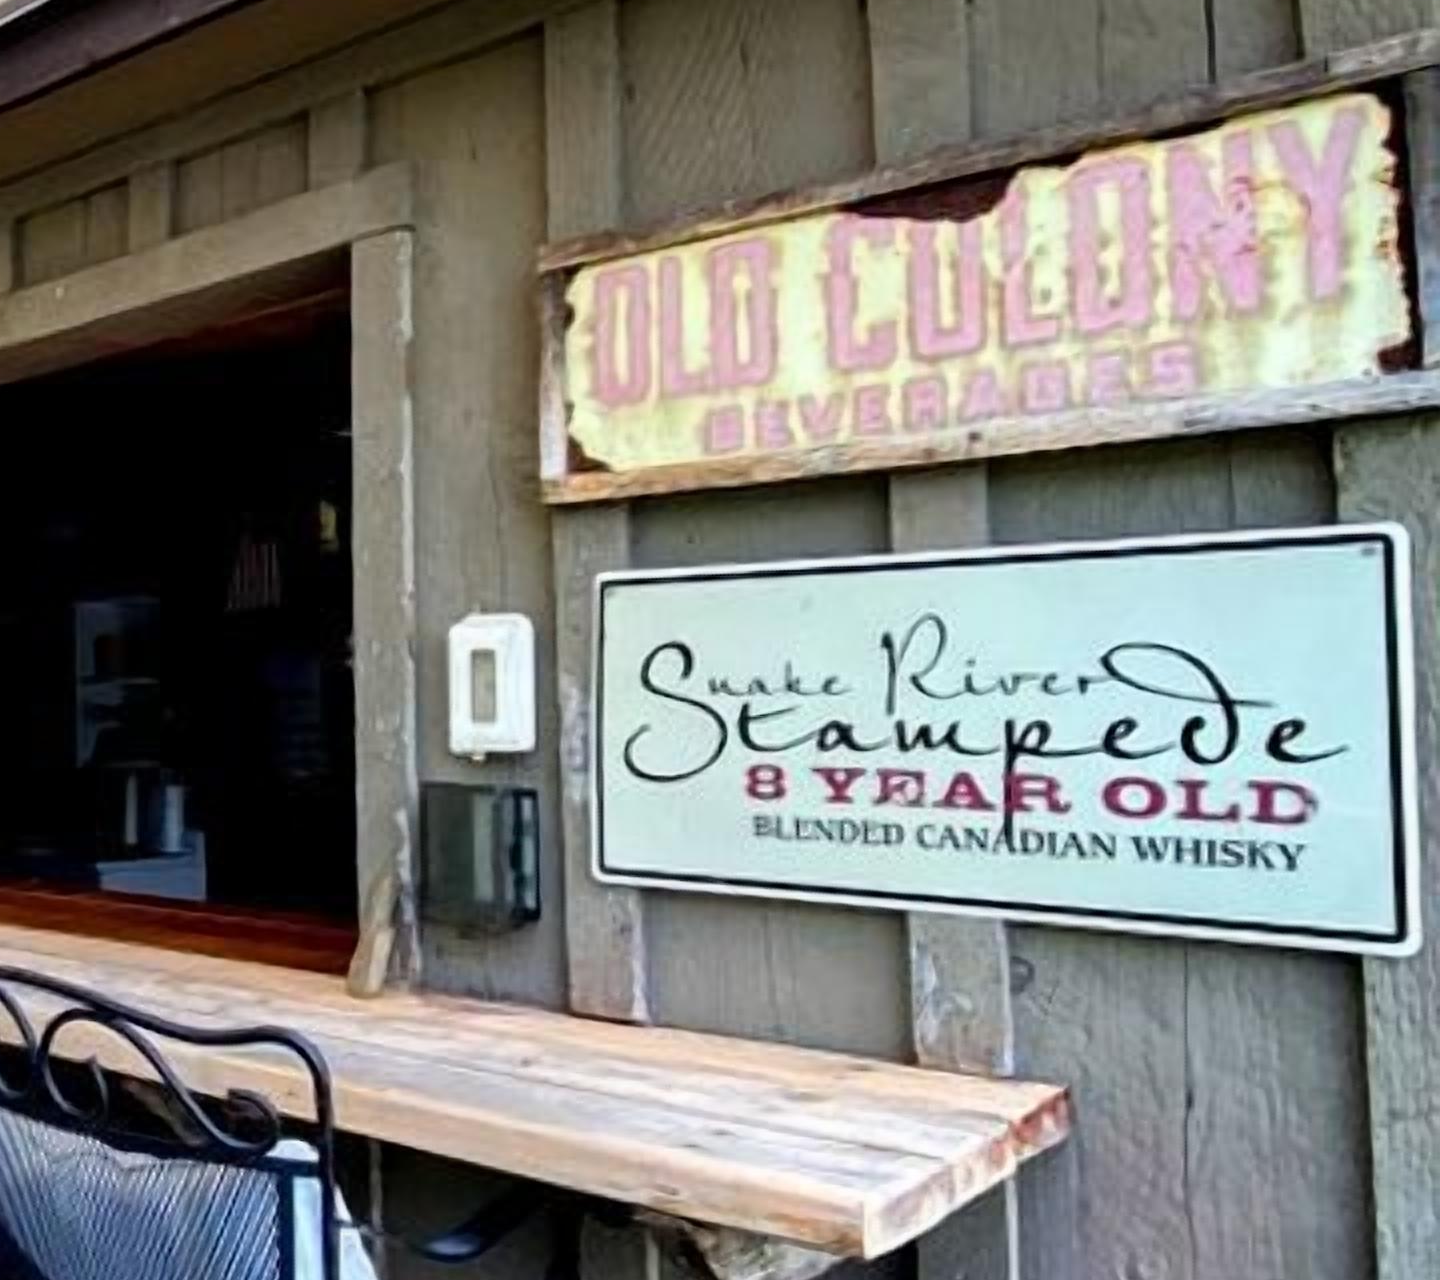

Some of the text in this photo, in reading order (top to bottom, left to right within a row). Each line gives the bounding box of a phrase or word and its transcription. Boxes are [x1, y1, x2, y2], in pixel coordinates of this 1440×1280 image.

[592, 102, 1368, 410] OLD COLONY
[880, 611, 1118, 717] River
[744, 763, 1322, 826] 8 YEAR OLD
[752, 814, 1309, 873] BLENDED CANADIAN WHISKY
